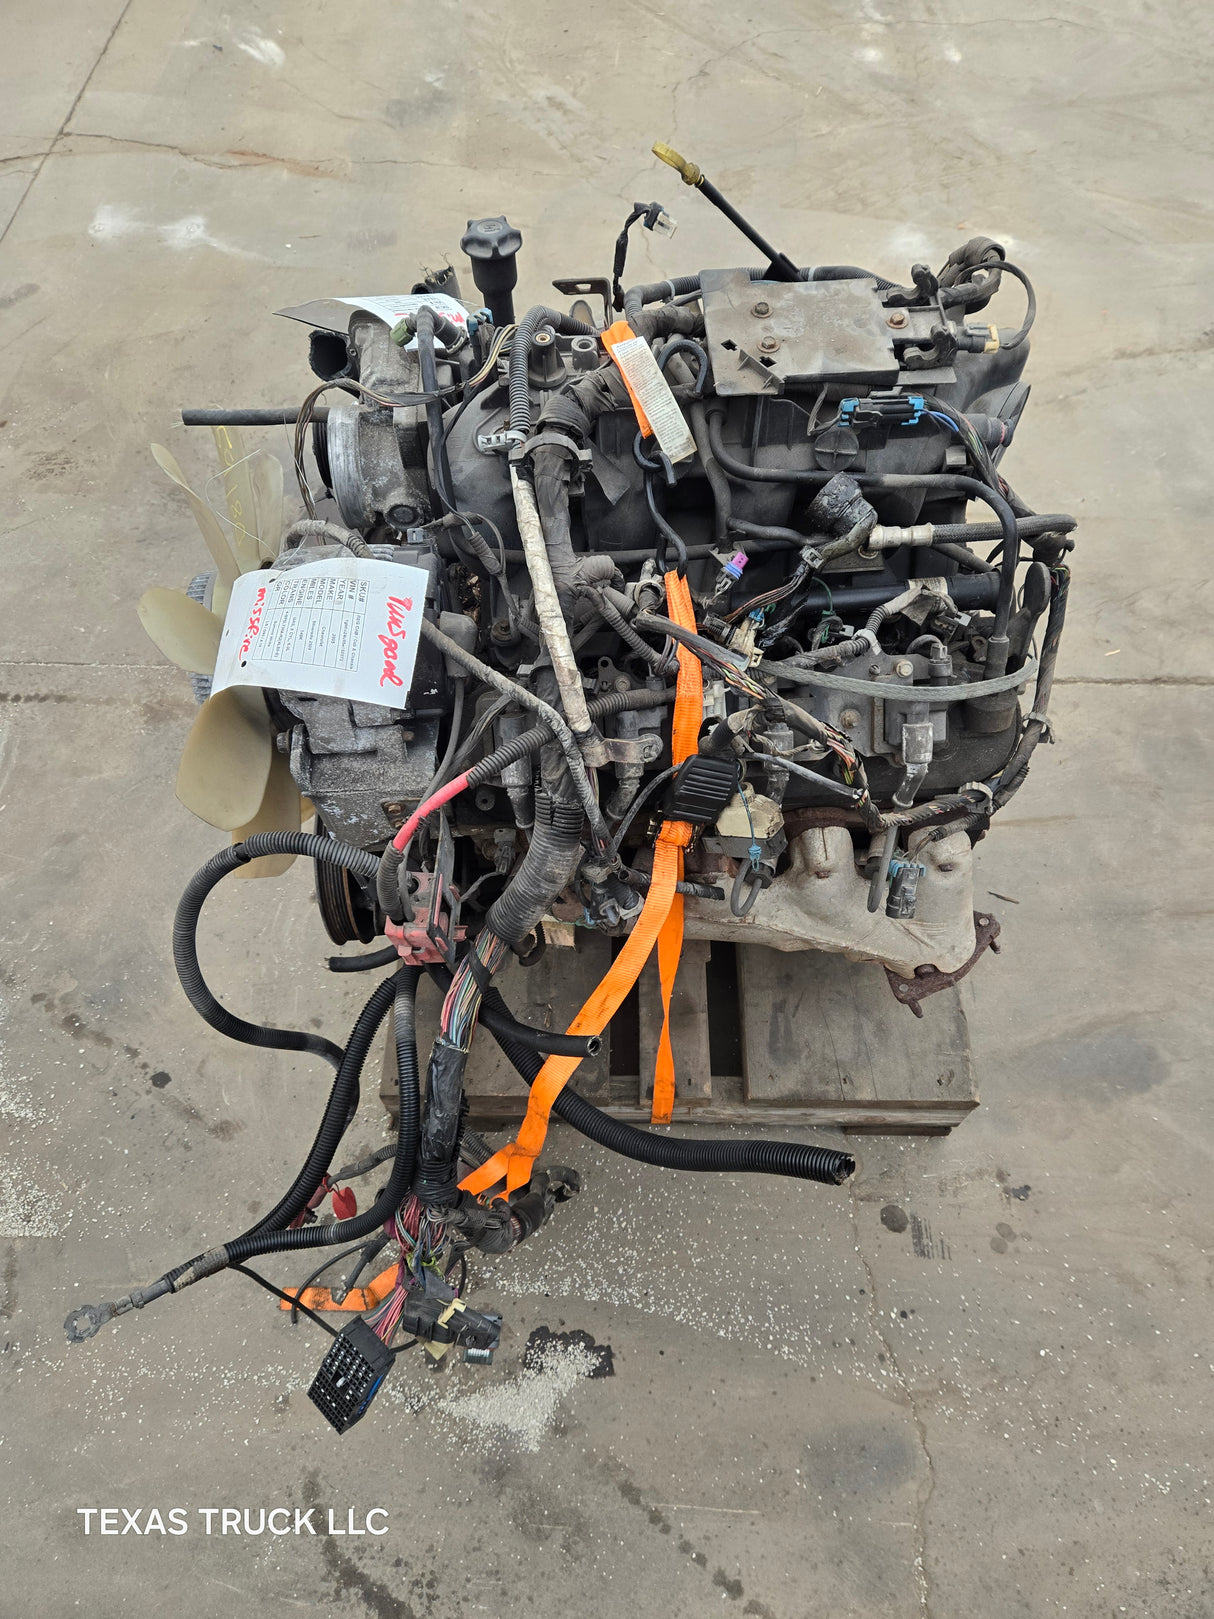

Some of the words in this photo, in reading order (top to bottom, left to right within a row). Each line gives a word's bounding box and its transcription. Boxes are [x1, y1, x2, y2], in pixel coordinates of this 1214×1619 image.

[279, 580, 290, 605] COLOR
[288, 579, 298, 603] TRANS
[296, 578, 306, 606] ENGINE
[306, 578, 317, 600] MILES
[315, 578, 326, 605] MODEL
[326, 578, 336, 600] MAKE
[337, 579, 346, 600] YEAR
[349, 580, 357, 592] VIN
[359, 581, 368, 602] SKU#
